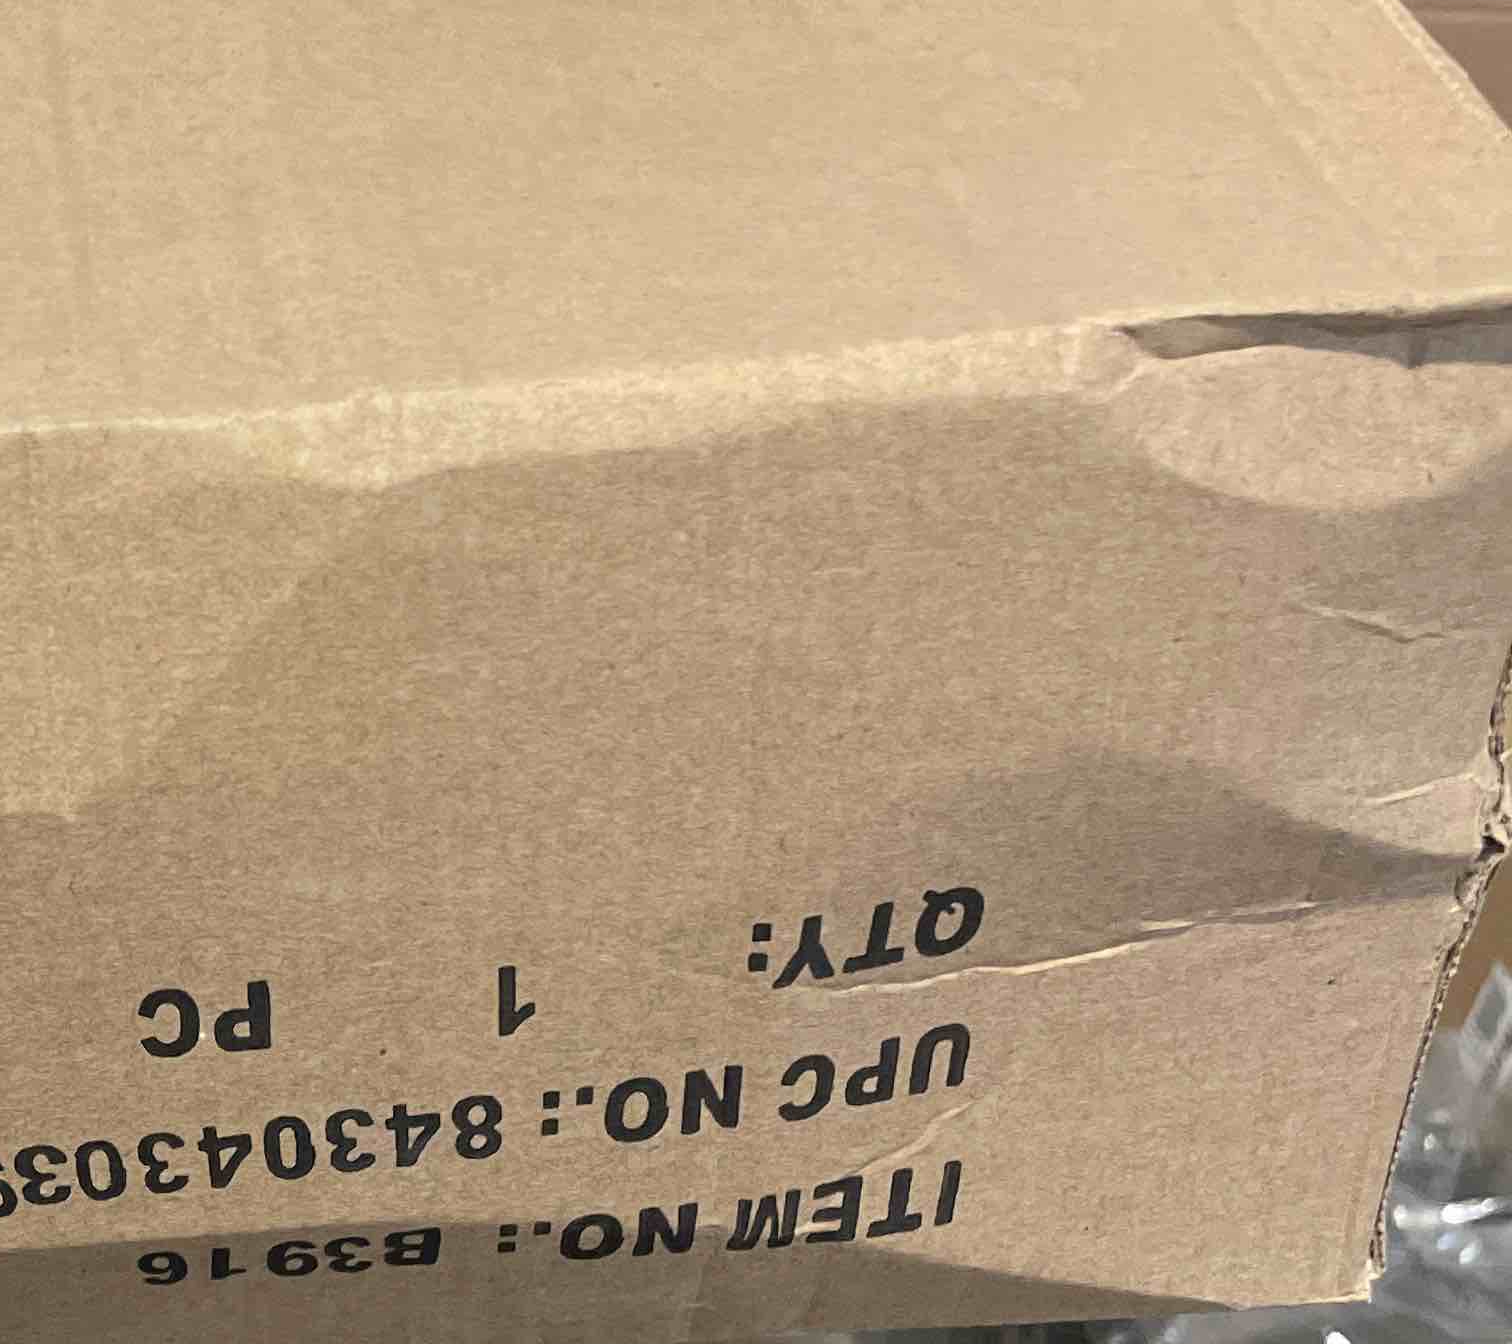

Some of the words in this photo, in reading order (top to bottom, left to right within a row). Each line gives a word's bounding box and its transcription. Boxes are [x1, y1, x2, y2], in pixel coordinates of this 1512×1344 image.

[748, 887, 984, 989] QTY:
[138, 980, 271, 1057] PC
[498, 966, 535, 1036] 1
[541, 1065, 743, 1142] NO.:
[779, 1024, 970, 1121] UPC
[498, 1203, 698, 1260] NO.:
[726, 1161, 962, 1250] ITEM
[138, 1227, 441, 1285] B3916
